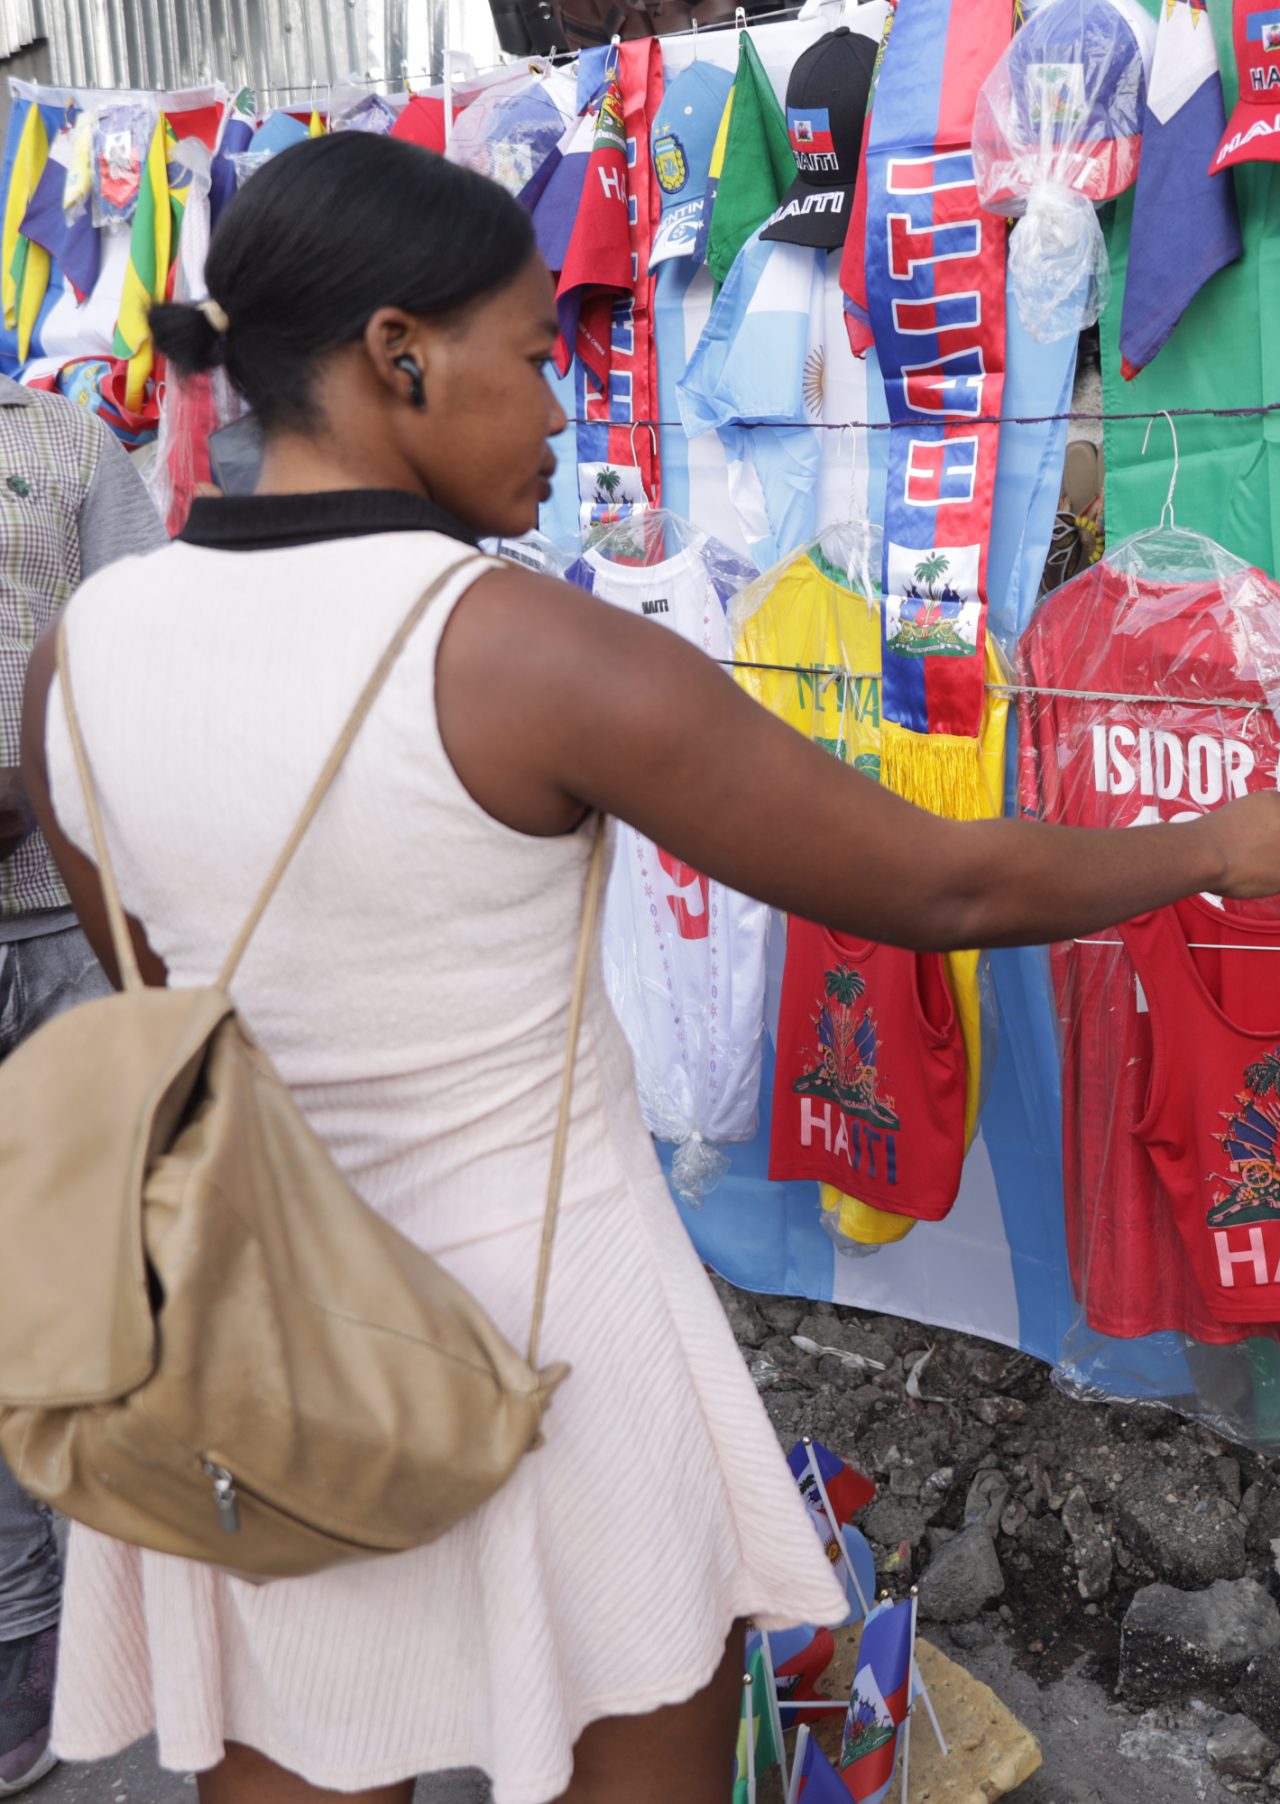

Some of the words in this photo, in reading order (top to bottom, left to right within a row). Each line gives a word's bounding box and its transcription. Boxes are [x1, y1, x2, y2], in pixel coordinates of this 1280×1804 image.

[886, 150, 986, 506] HAITI
[641, 598, 670, 615] HAITI
[1092, 725, 1256, 805] ISIDOR
[800, 1097, 898, 1185] HAITI
